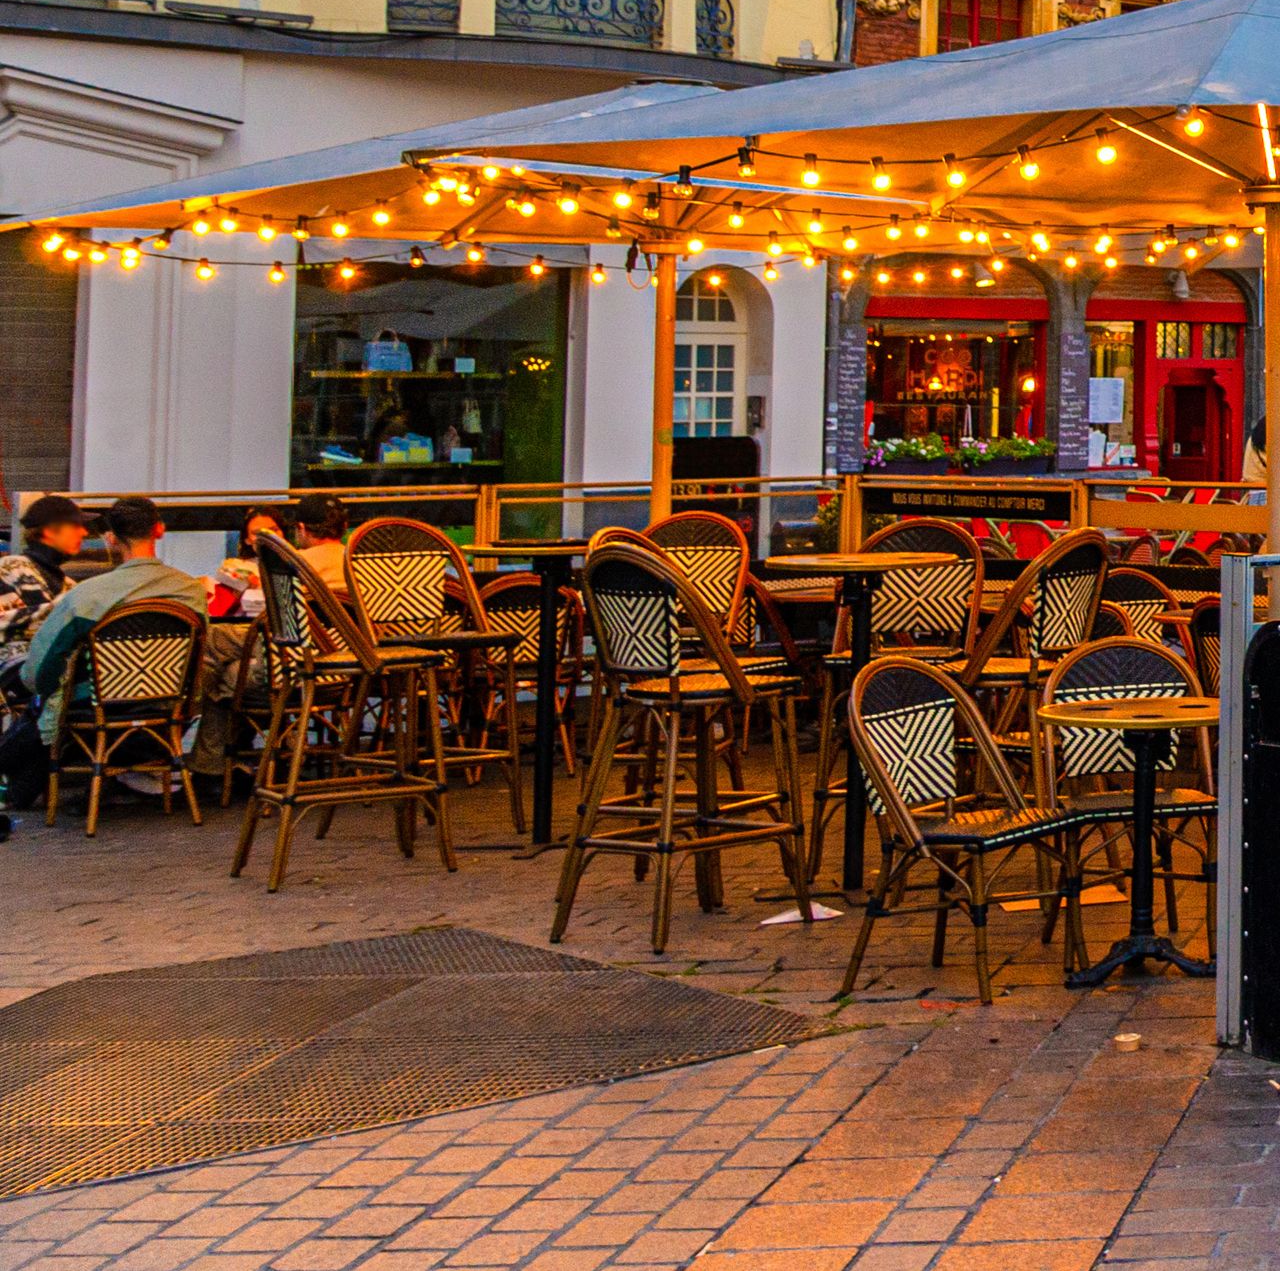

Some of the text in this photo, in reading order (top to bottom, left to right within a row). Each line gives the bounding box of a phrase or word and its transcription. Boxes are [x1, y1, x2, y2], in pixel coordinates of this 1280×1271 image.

[924, 348, 972, 365] COQ
[910, 368, 984, 388] HARDI
[893, 493, 907, 504] NOUS
[908, 493, 921, 505] VOUS
[923, 493, 947, 506] INVITONS
[953, 494, 987, 508] COMMANDER
[997, 496, 1026, 509] COMPTOIR
[1027, 498, 1045, 510] MERCI
